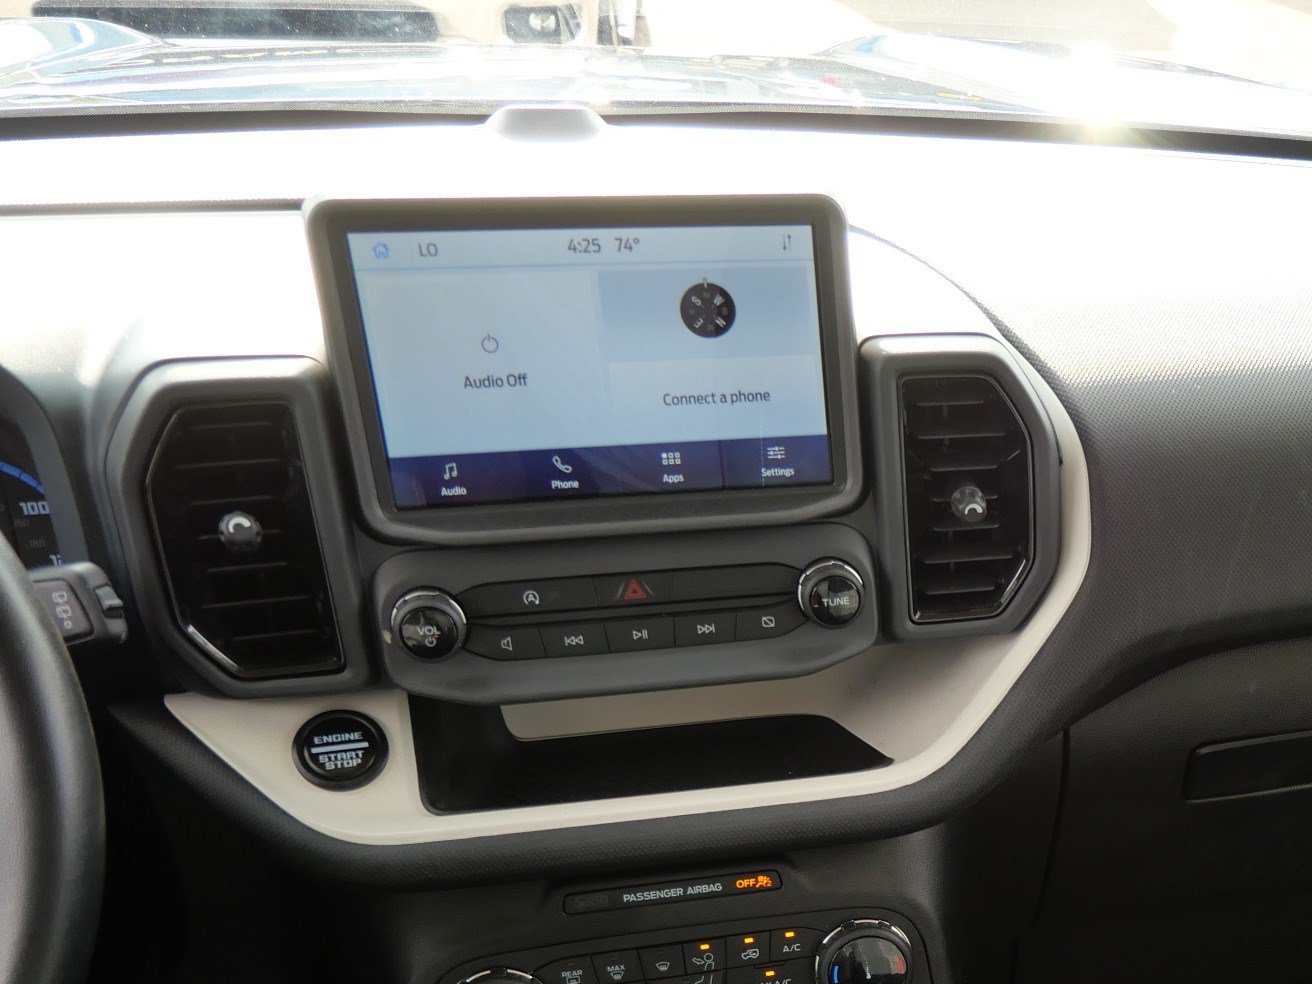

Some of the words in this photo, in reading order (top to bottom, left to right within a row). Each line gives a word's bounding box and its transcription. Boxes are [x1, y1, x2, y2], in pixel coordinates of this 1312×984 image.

[418, 242, 439, 257] LO
[567, 238, 601, 254] 4:25
[614, 237, 640, 252] 74°
[463, 374, 504, 389] Audio
[507, 372, 528, 388] Off
[663, 391, 717, 406] Connect
[719, 394, 728, 404] a
[730, 389, 771, 406] phone
[662, 472, 684, 484] Apps
[761, 466, 795, 478] Settings
[551, 479, 579, 490] Phone
[441, 485, 467, 497] Audio
[19, 501, 50, 515] 100
[822, 596, 850, 607] TUNE
[417, 626, 441, 636] VOL
[313, 731, 363, 744] ENGINE
[318, 750, 364, 763] START
[325, 759, 361, 770] STOP
[736, 878, 756, 888] OFF
[623, 888, 684, 903] PASSENGER
[687, 883, 723, 895] AIRBAG
[782, 943, 801, 953] A/C
[561, 969, 583, 978] REAR
[607, 964, 626, 973] MAX
